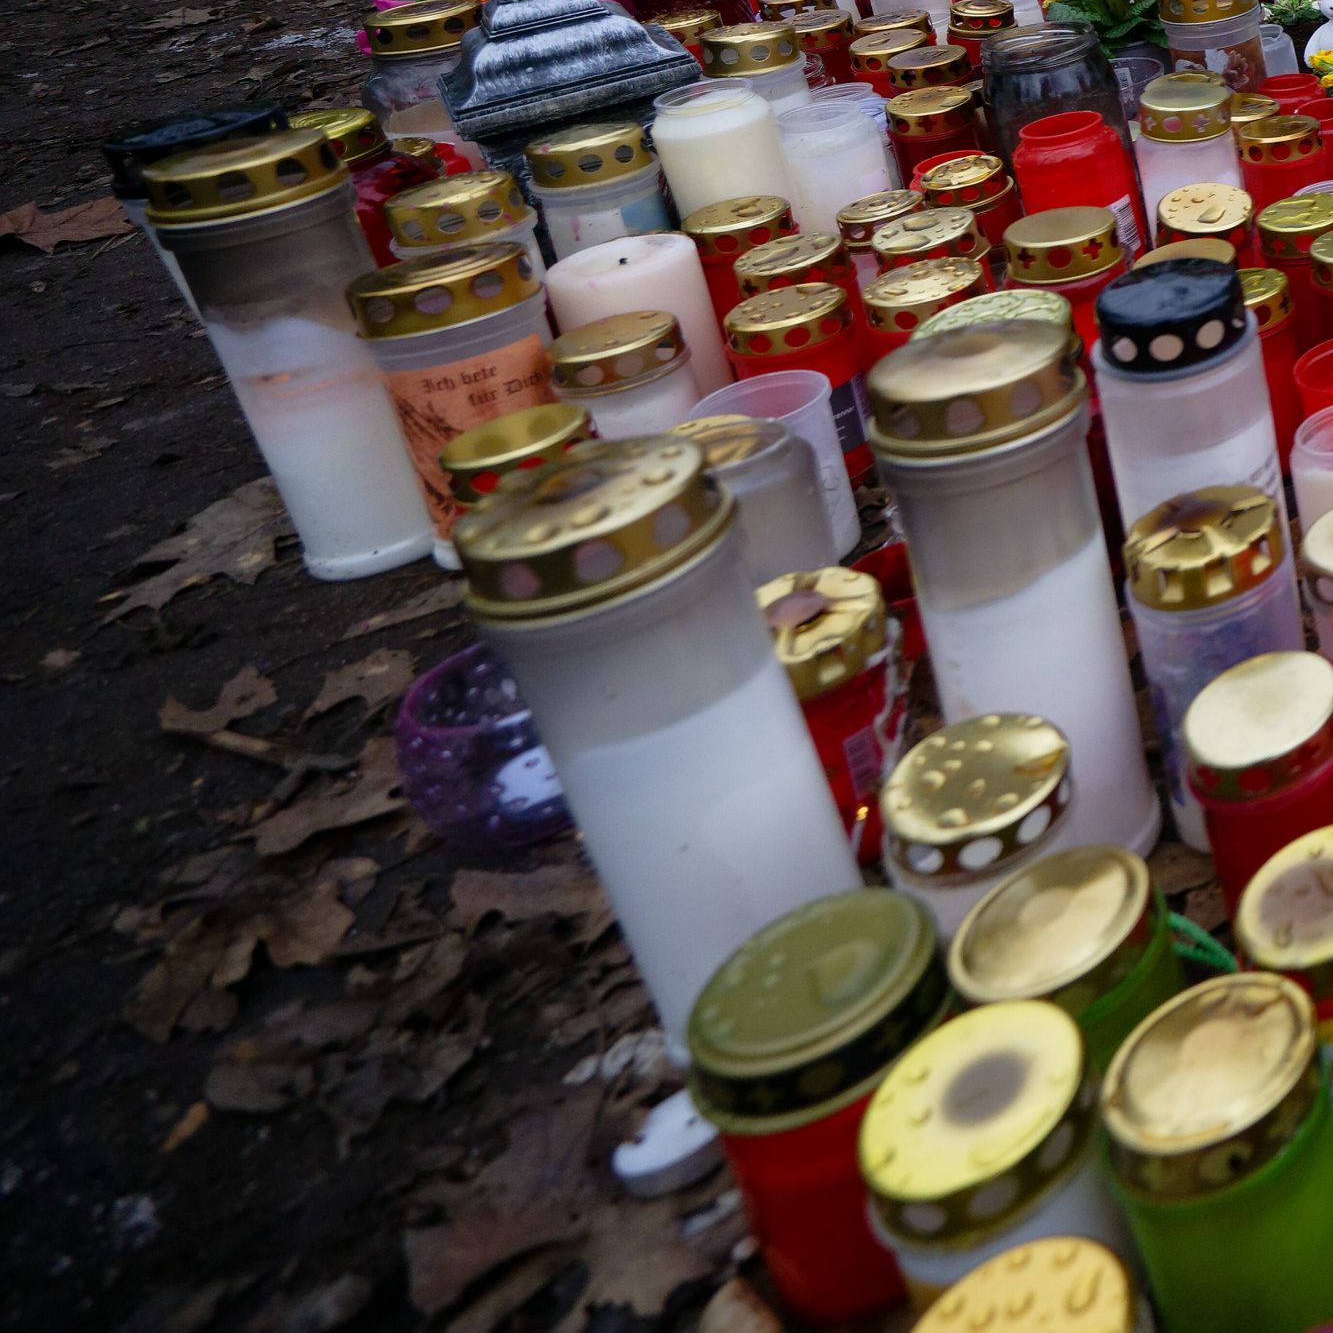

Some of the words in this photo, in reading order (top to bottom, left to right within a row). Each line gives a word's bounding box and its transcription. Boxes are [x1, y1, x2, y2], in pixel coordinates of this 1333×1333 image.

[422, 377, 456, 394] Ich
[461, 366, 498, 384] bete
[468, 389, 498, 406] für
